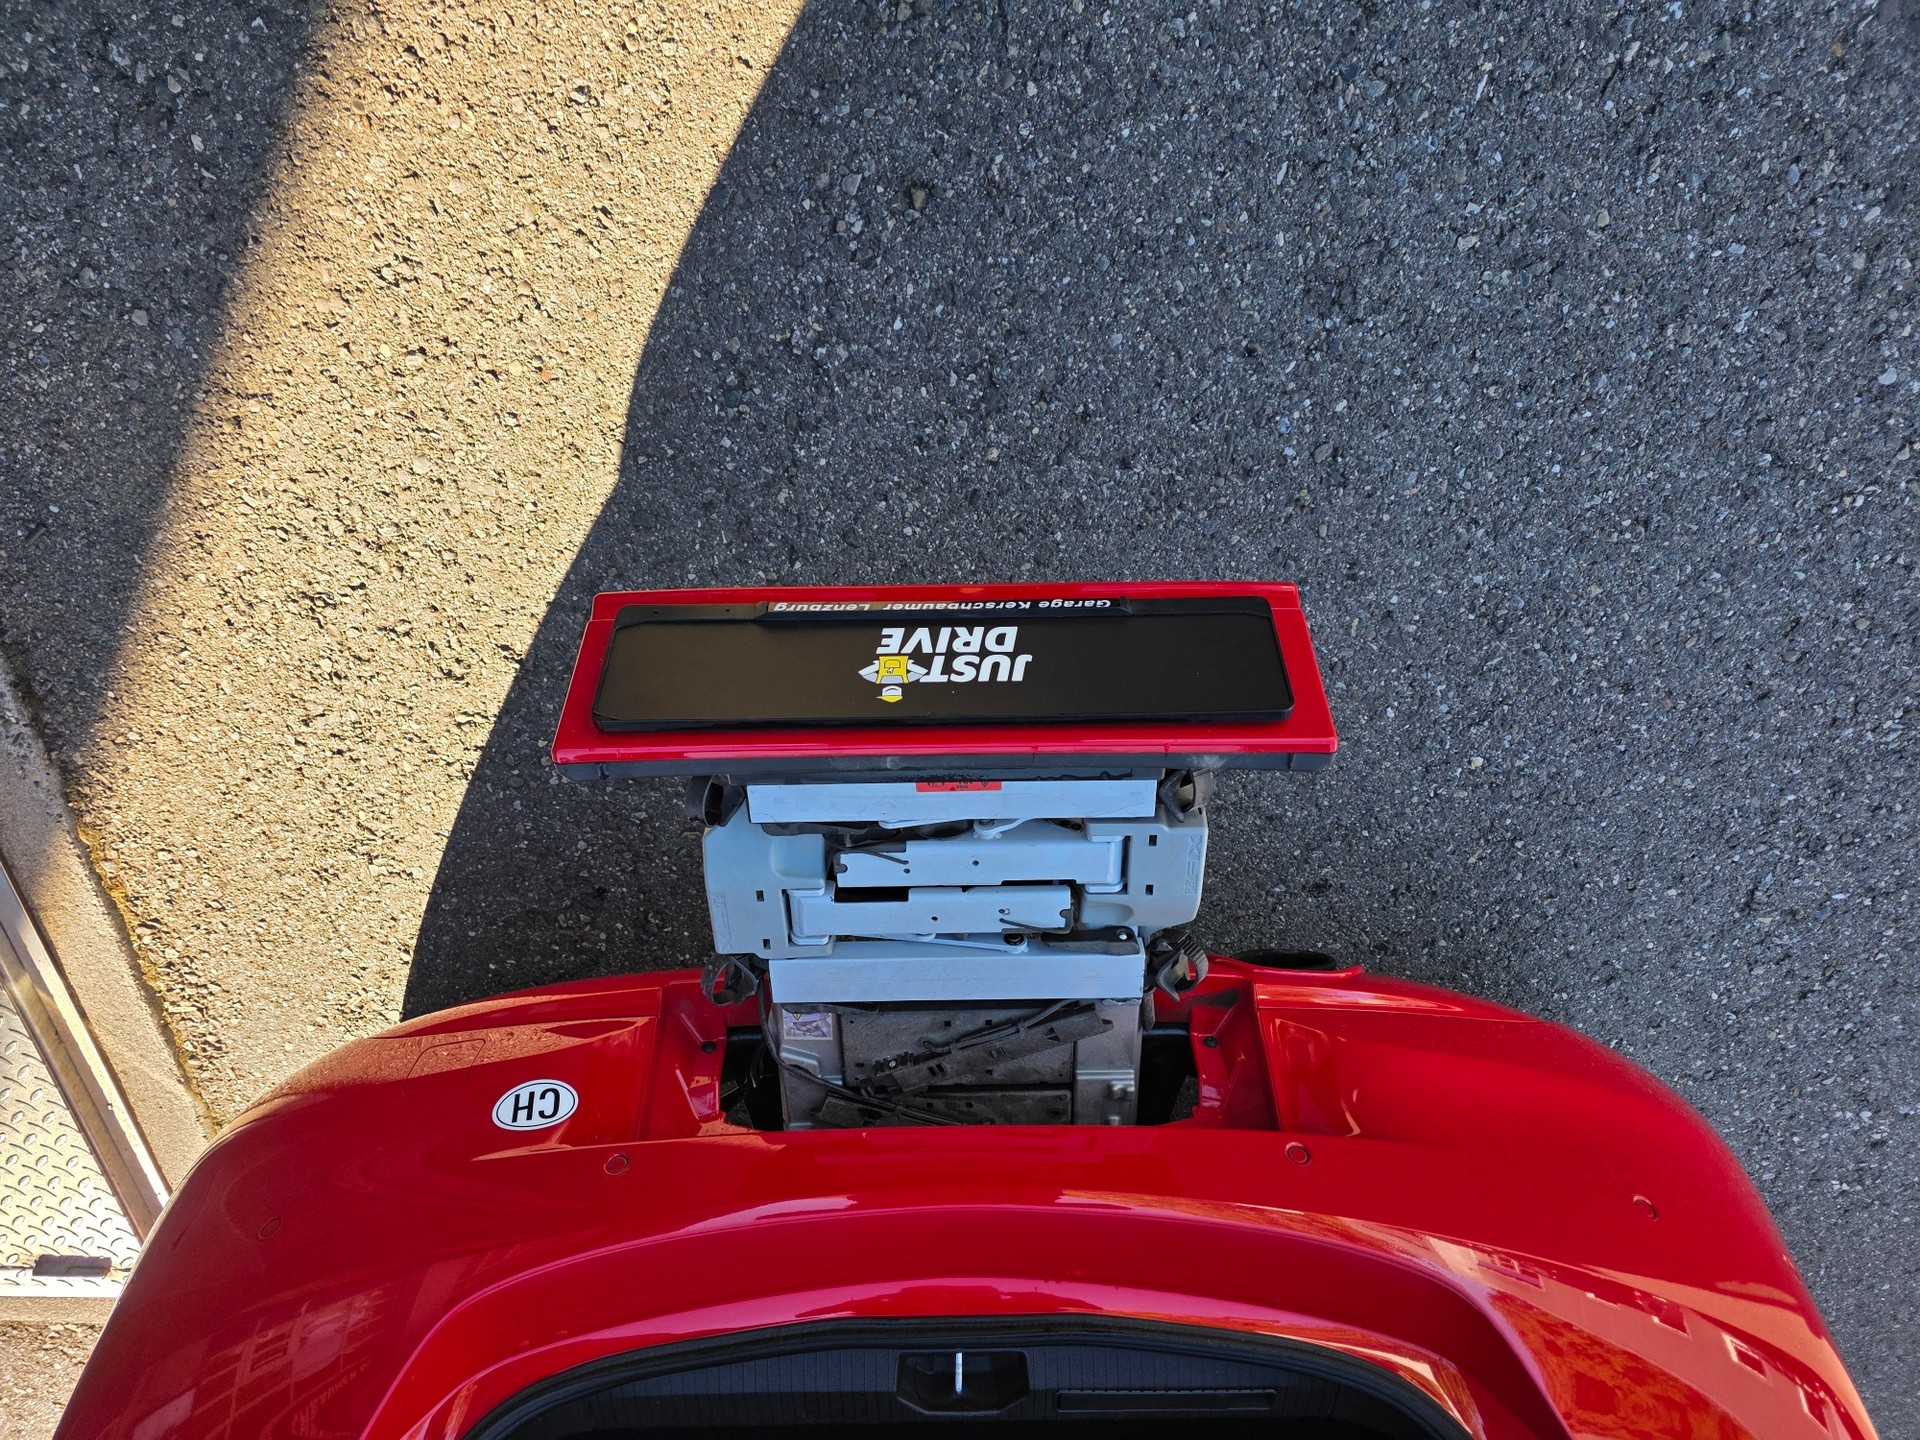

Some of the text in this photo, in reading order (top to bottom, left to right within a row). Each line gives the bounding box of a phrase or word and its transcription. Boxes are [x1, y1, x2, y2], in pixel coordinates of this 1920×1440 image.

[774, 599, 1111, 612] Garage Kerschbaumer Lenzburg
[876, 626, 1018, 655] DRIVE
[919, 654, 1033, 683] JUST
[511, 1087, 560, 1123] CH
